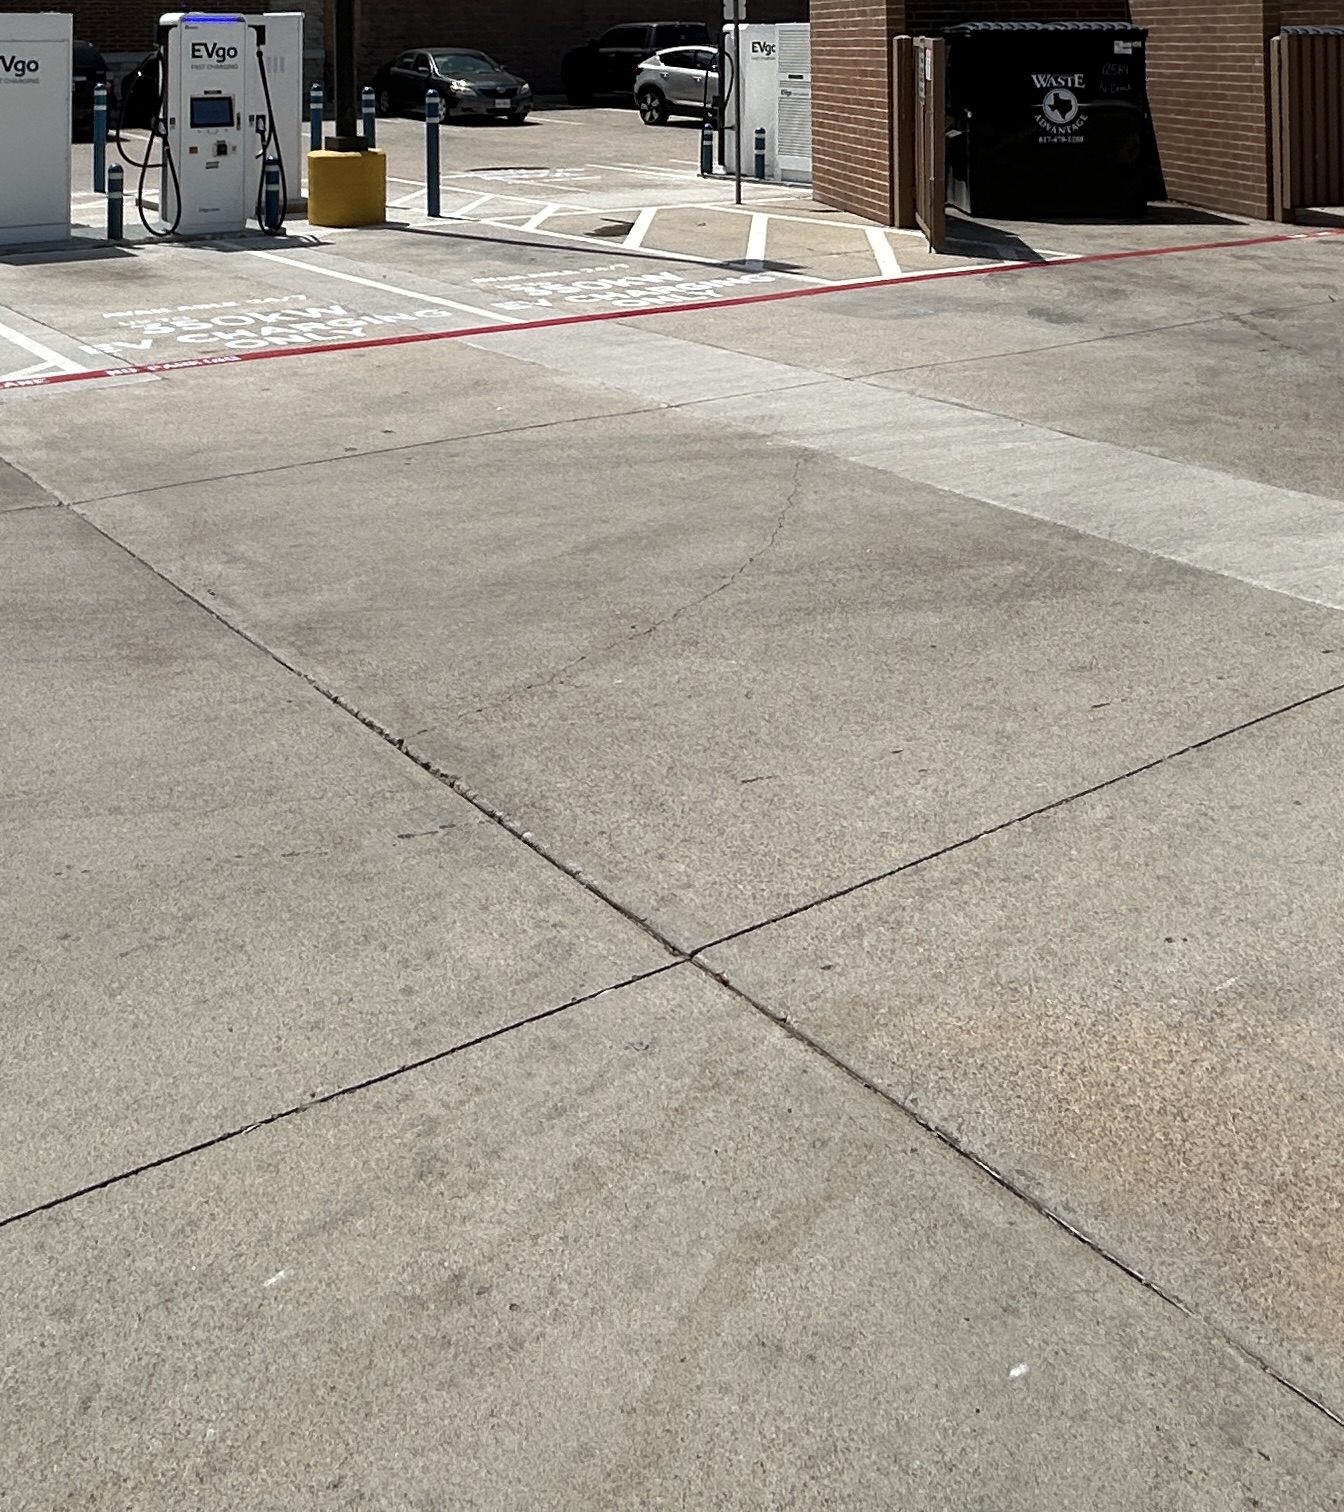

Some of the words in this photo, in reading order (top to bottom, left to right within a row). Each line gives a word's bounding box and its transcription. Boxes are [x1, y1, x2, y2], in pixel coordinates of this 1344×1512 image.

[191, 42, 238, 63] EVgo
[1031, 74, 1086, 88] WASTE
[1034, 113, 1089, 134] ADVANTAGE
[490, 298, 553, 310] EV
[564, 273, 776, 303] CHARGING
[611, 289, 724, 307] ONLY
[77, 339, 153, 355] EV
[176, 308, 453, 344] CHARGING
[225, 326, 366, 349] ONLY
[105, 367, 138, 376] NO
[147, 356, 242, 371] PARKING
